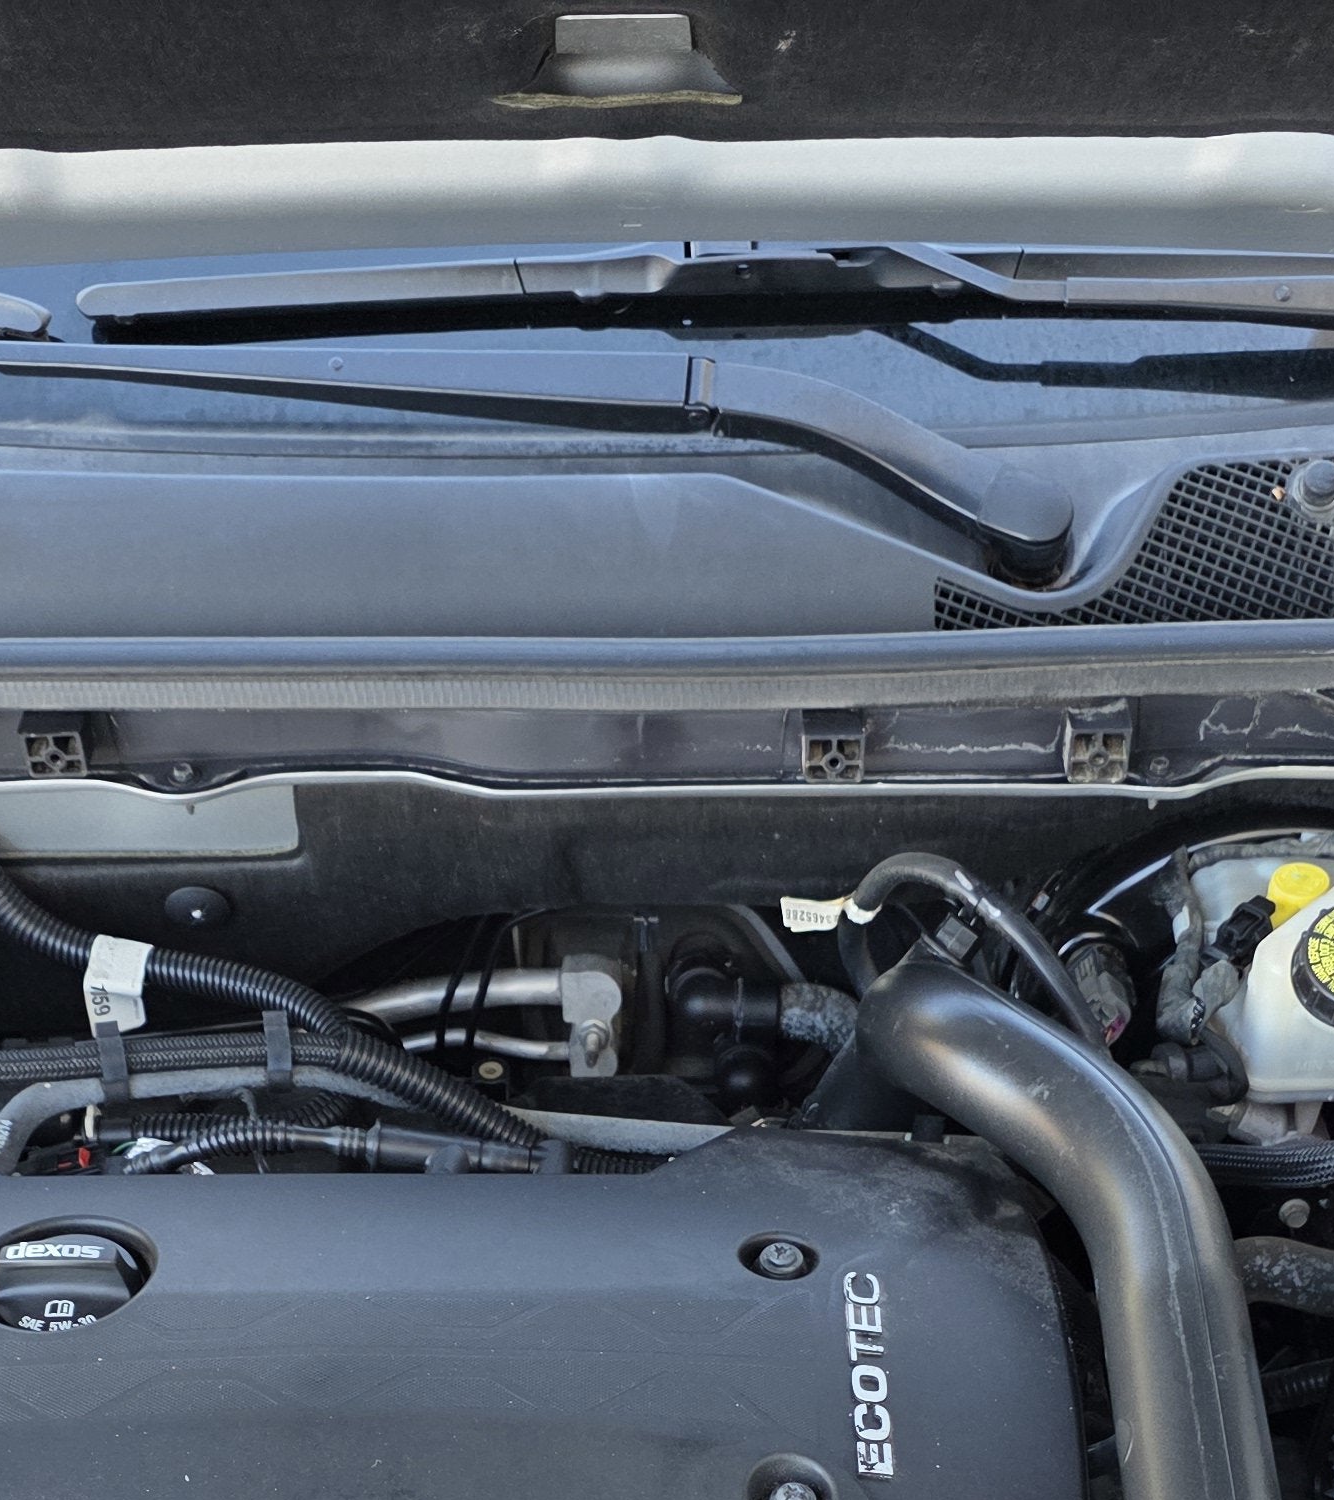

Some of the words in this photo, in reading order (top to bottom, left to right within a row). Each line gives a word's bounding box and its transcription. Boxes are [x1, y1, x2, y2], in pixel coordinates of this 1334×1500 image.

[6, 1242, 105, 1259] dexos
[18, 1315, 46, 1332] SAE
[49, 1314, 97, 1332] 5W-30
[844, 1271, 894, 1478] ECOTEC
